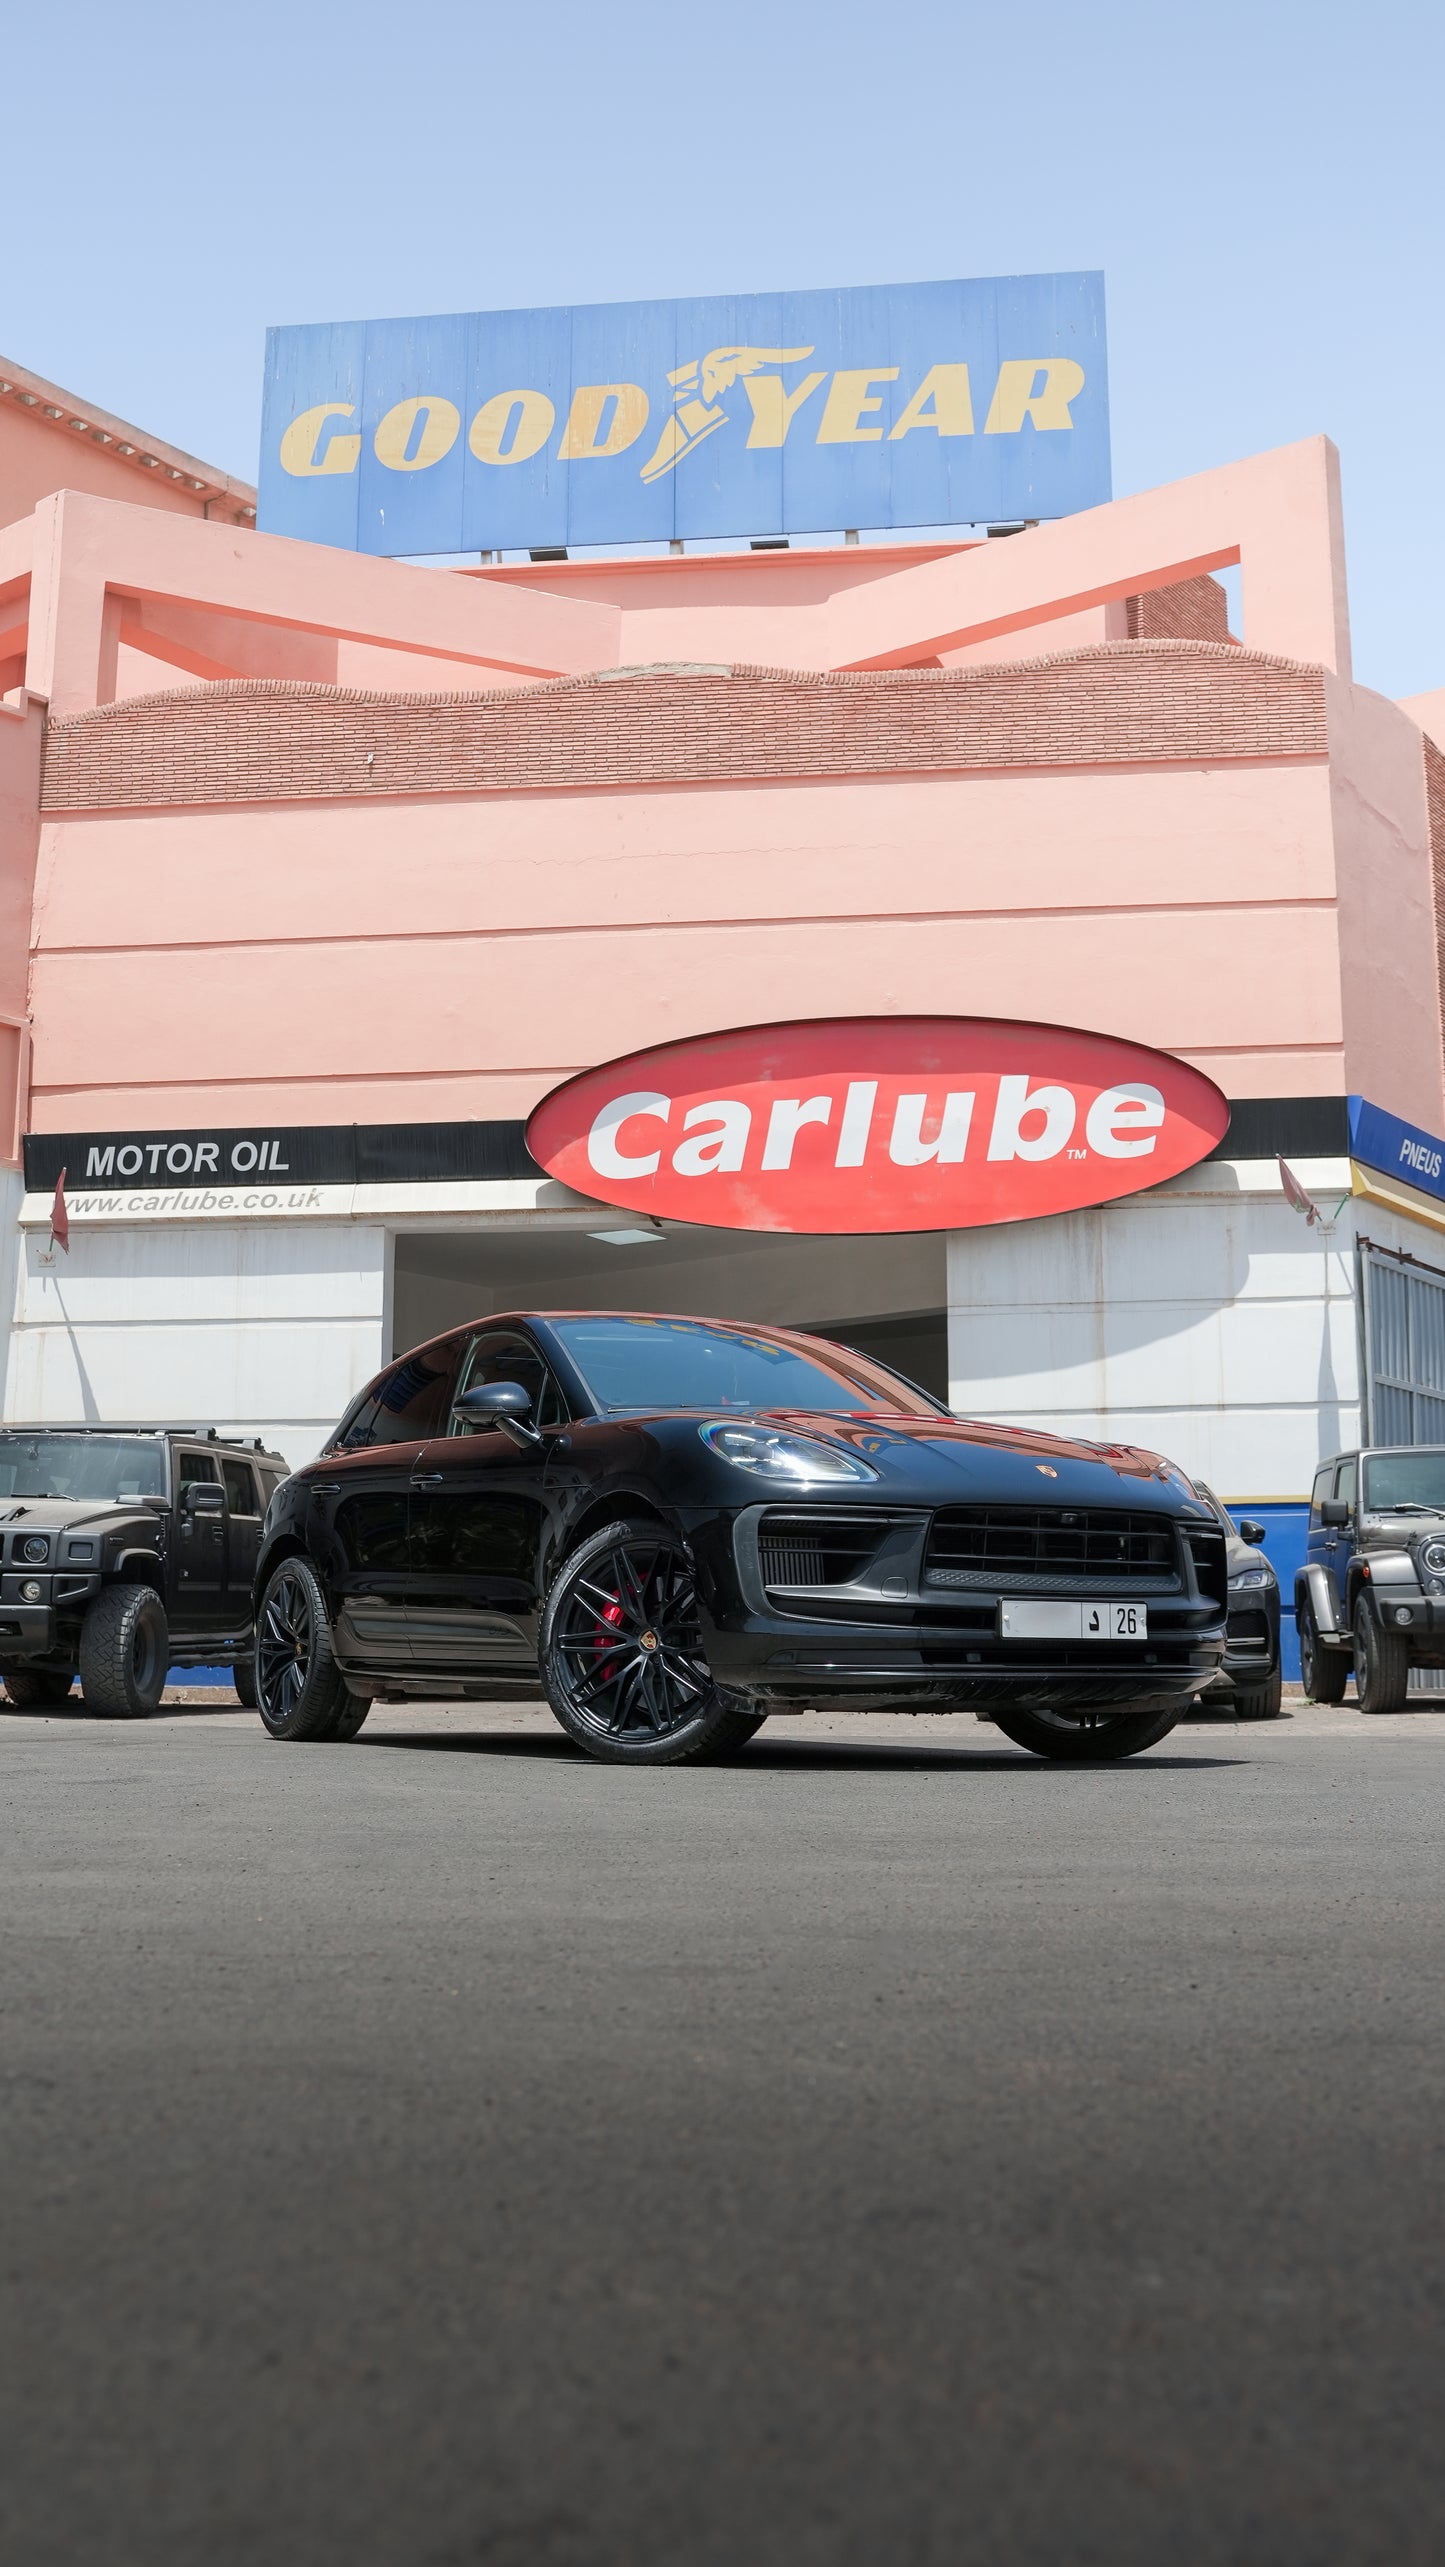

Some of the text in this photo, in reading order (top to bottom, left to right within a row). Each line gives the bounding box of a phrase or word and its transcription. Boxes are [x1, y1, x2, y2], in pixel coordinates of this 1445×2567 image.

[587, 1074, 1165, 1180] Carlube
[86, 1140, 289, 1177] MOTOR OIL
[1065, 1148, 1088, 1160] TM
[1399, 1138, 1442, 1178] PNEUS
[1116, 1608, 1138, 1635] 26
